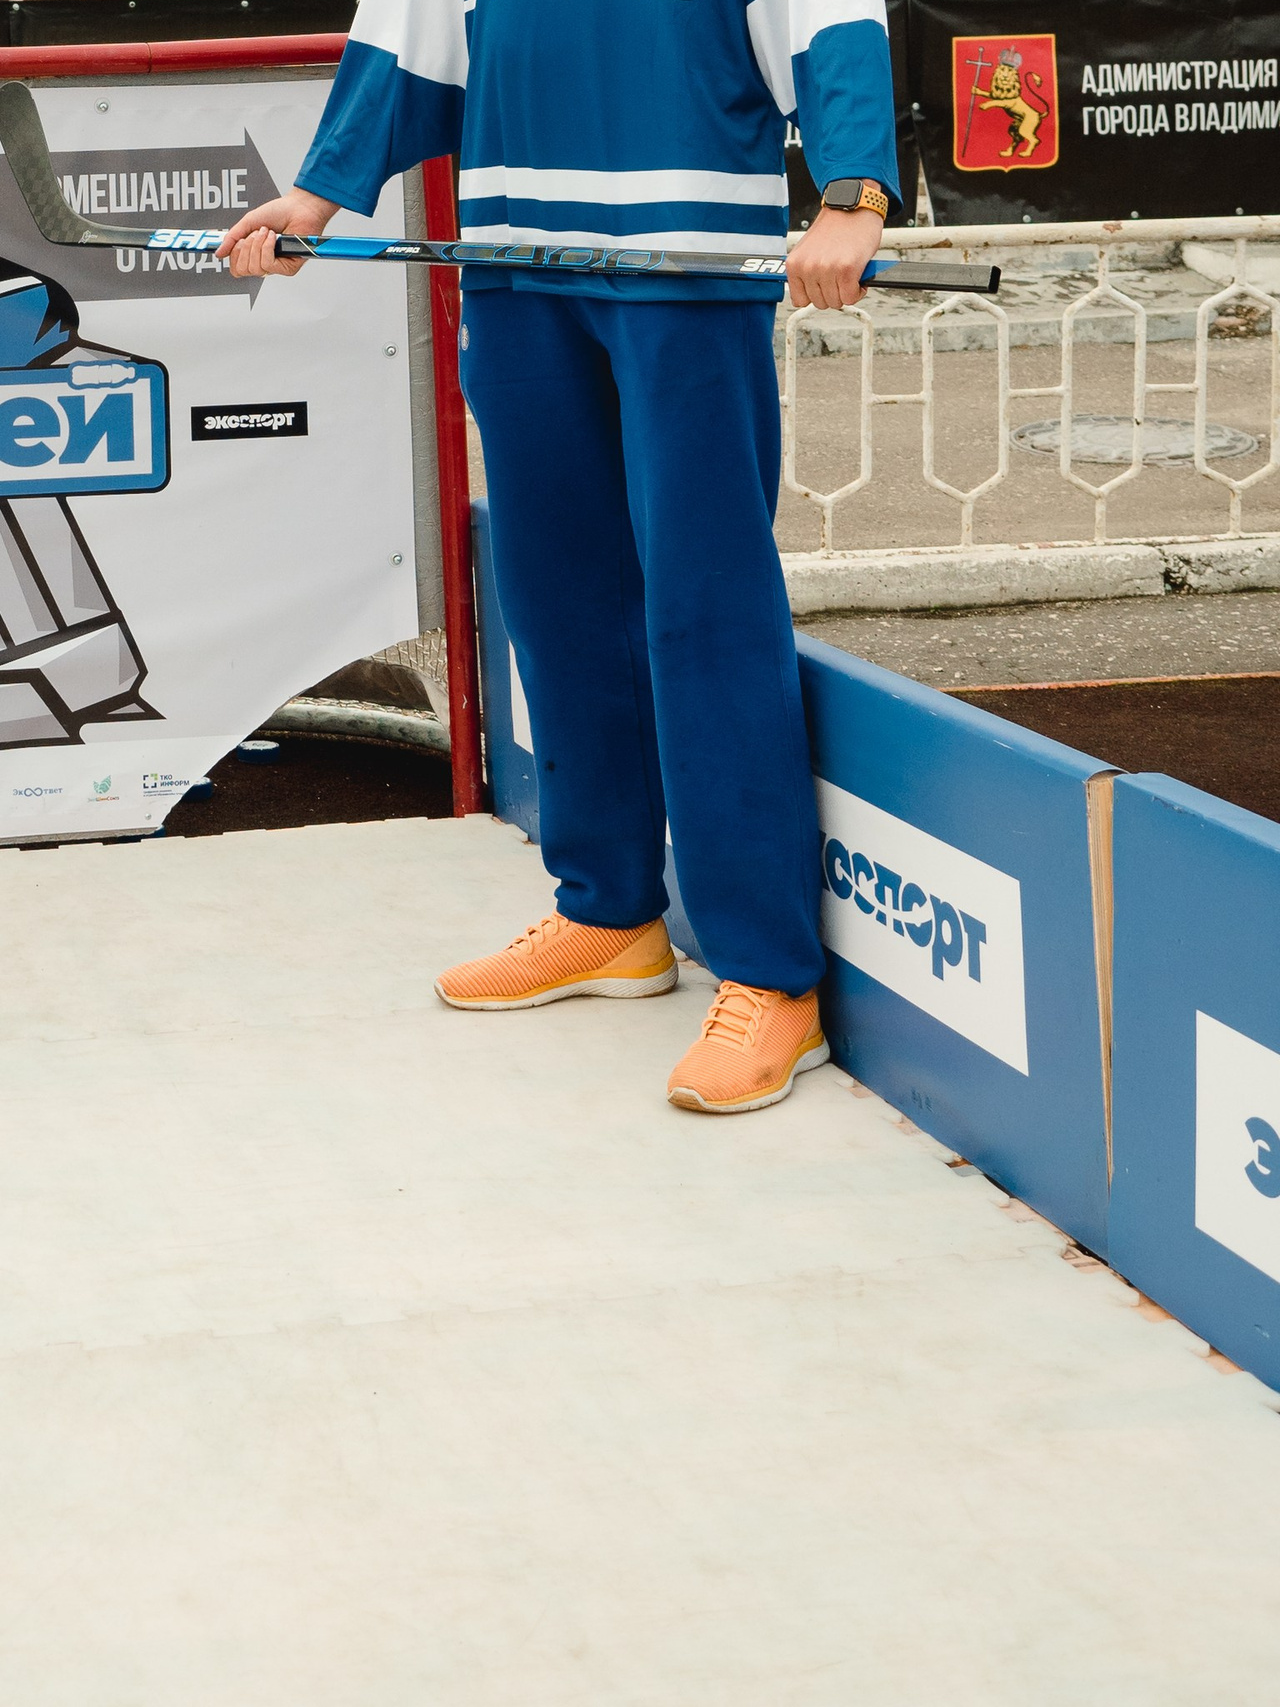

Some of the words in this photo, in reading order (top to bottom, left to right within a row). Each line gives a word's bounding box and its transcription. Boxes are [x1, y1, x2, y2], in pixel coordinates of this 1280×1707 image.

[1081, 58, 1278, 97] АДМИНИСТРАЦИЯ
[1082, 104, 1170, 137] ГОРОДА
[1175, 100, 1280, 134] ВЛАДИМИ
[56, 168, 249, 215] МЕШАННЫЕ
